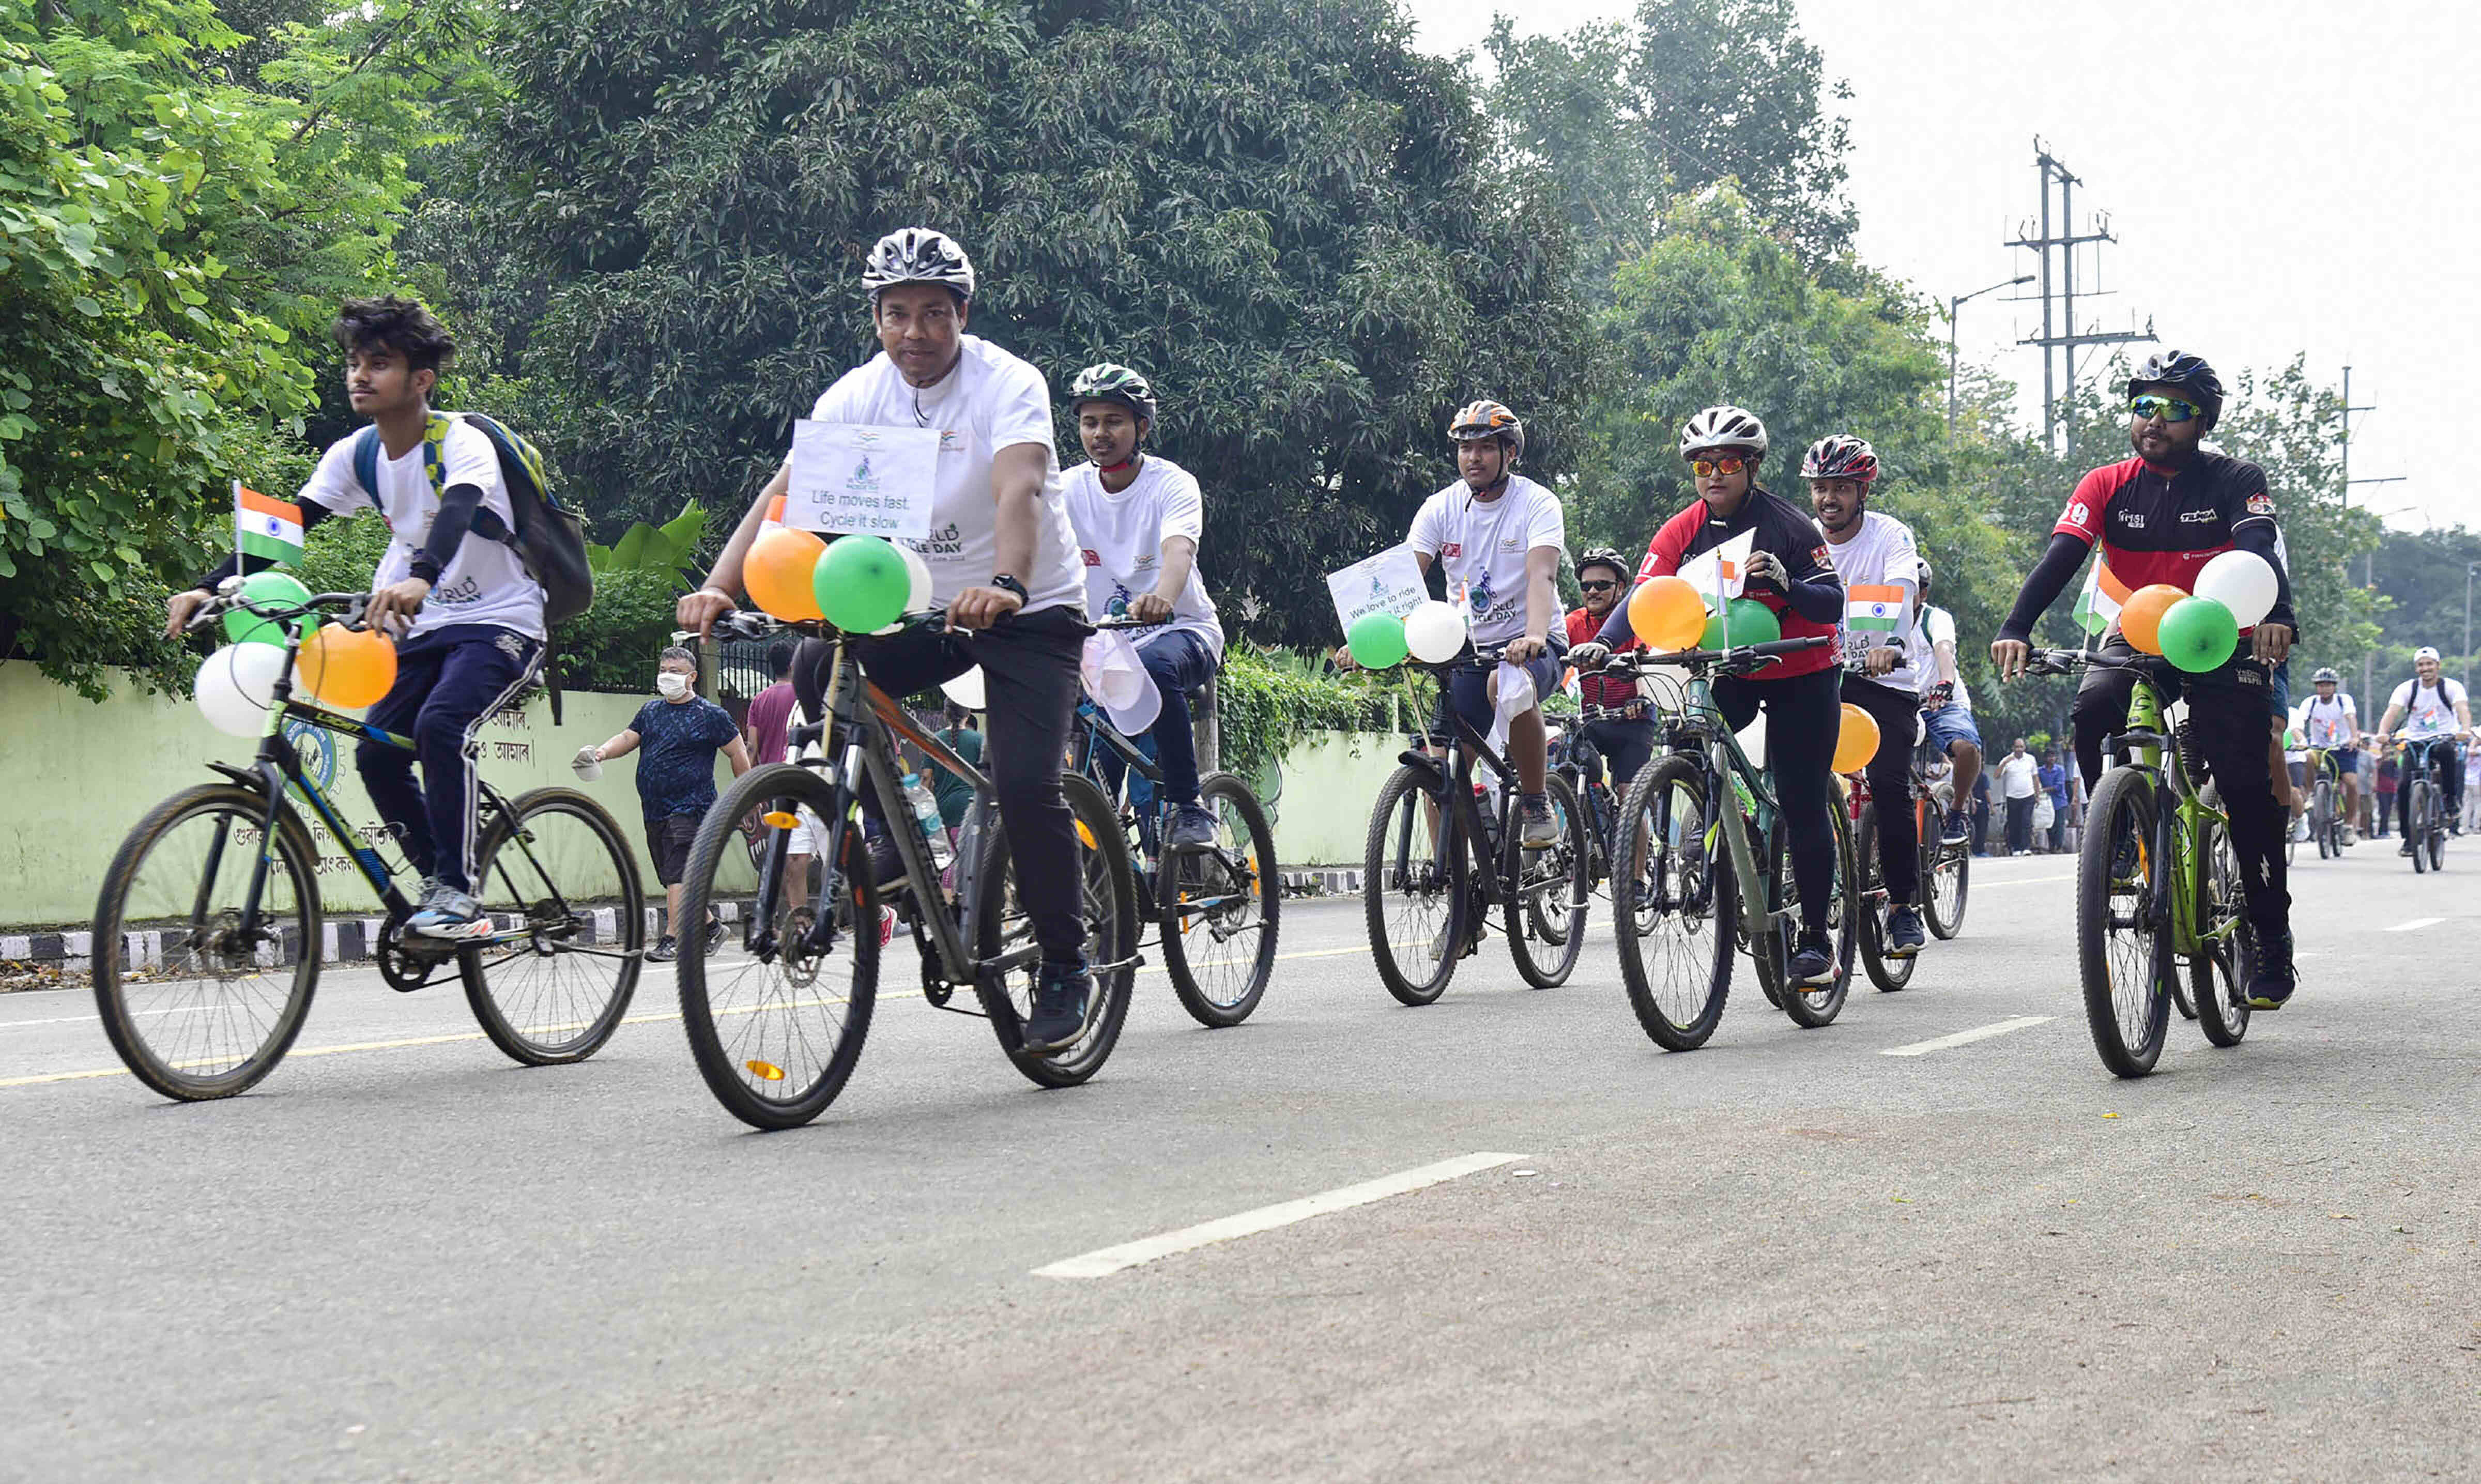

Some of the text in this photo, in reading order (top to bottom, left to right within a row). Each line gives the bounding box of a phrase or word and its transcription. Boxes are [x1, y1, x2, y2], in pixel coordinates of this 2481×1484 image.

[812, 490, 835, 504] Life
[839, 495, 879, 508] moves
[820, 511, 899, 529] Cycle it slow
[932, 542, 961, 554] DAY
[1366, 599, 1386, 612] love
[1387, 595, 1397, 603] to
[1399, 586, 1416, 598] ride
[1401, 596, 1422, 611] right
[1496, 610, 1517, 621] DAY
